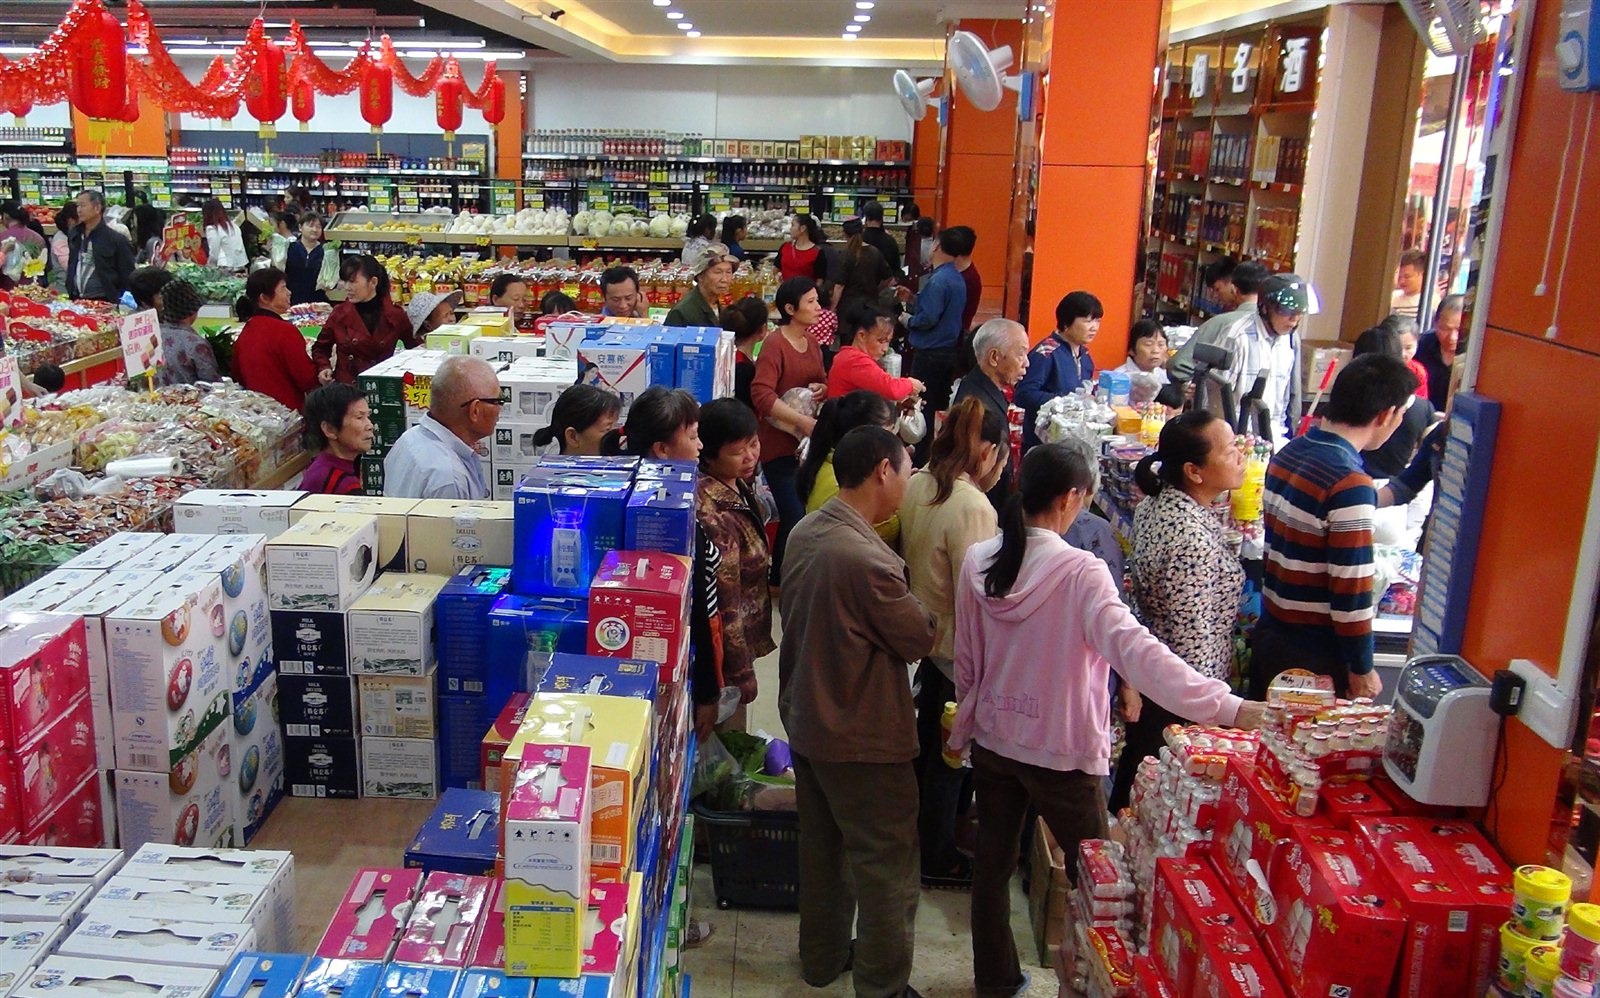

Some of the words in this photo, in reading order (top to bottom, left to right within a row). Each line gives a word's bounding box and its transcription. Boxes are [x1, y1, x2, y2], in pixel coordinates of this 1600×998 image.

[597, 353, 626, 364] 安慕希
[497, 431, 512, 442] 金典
[498, 472, 513, 482] 金典
